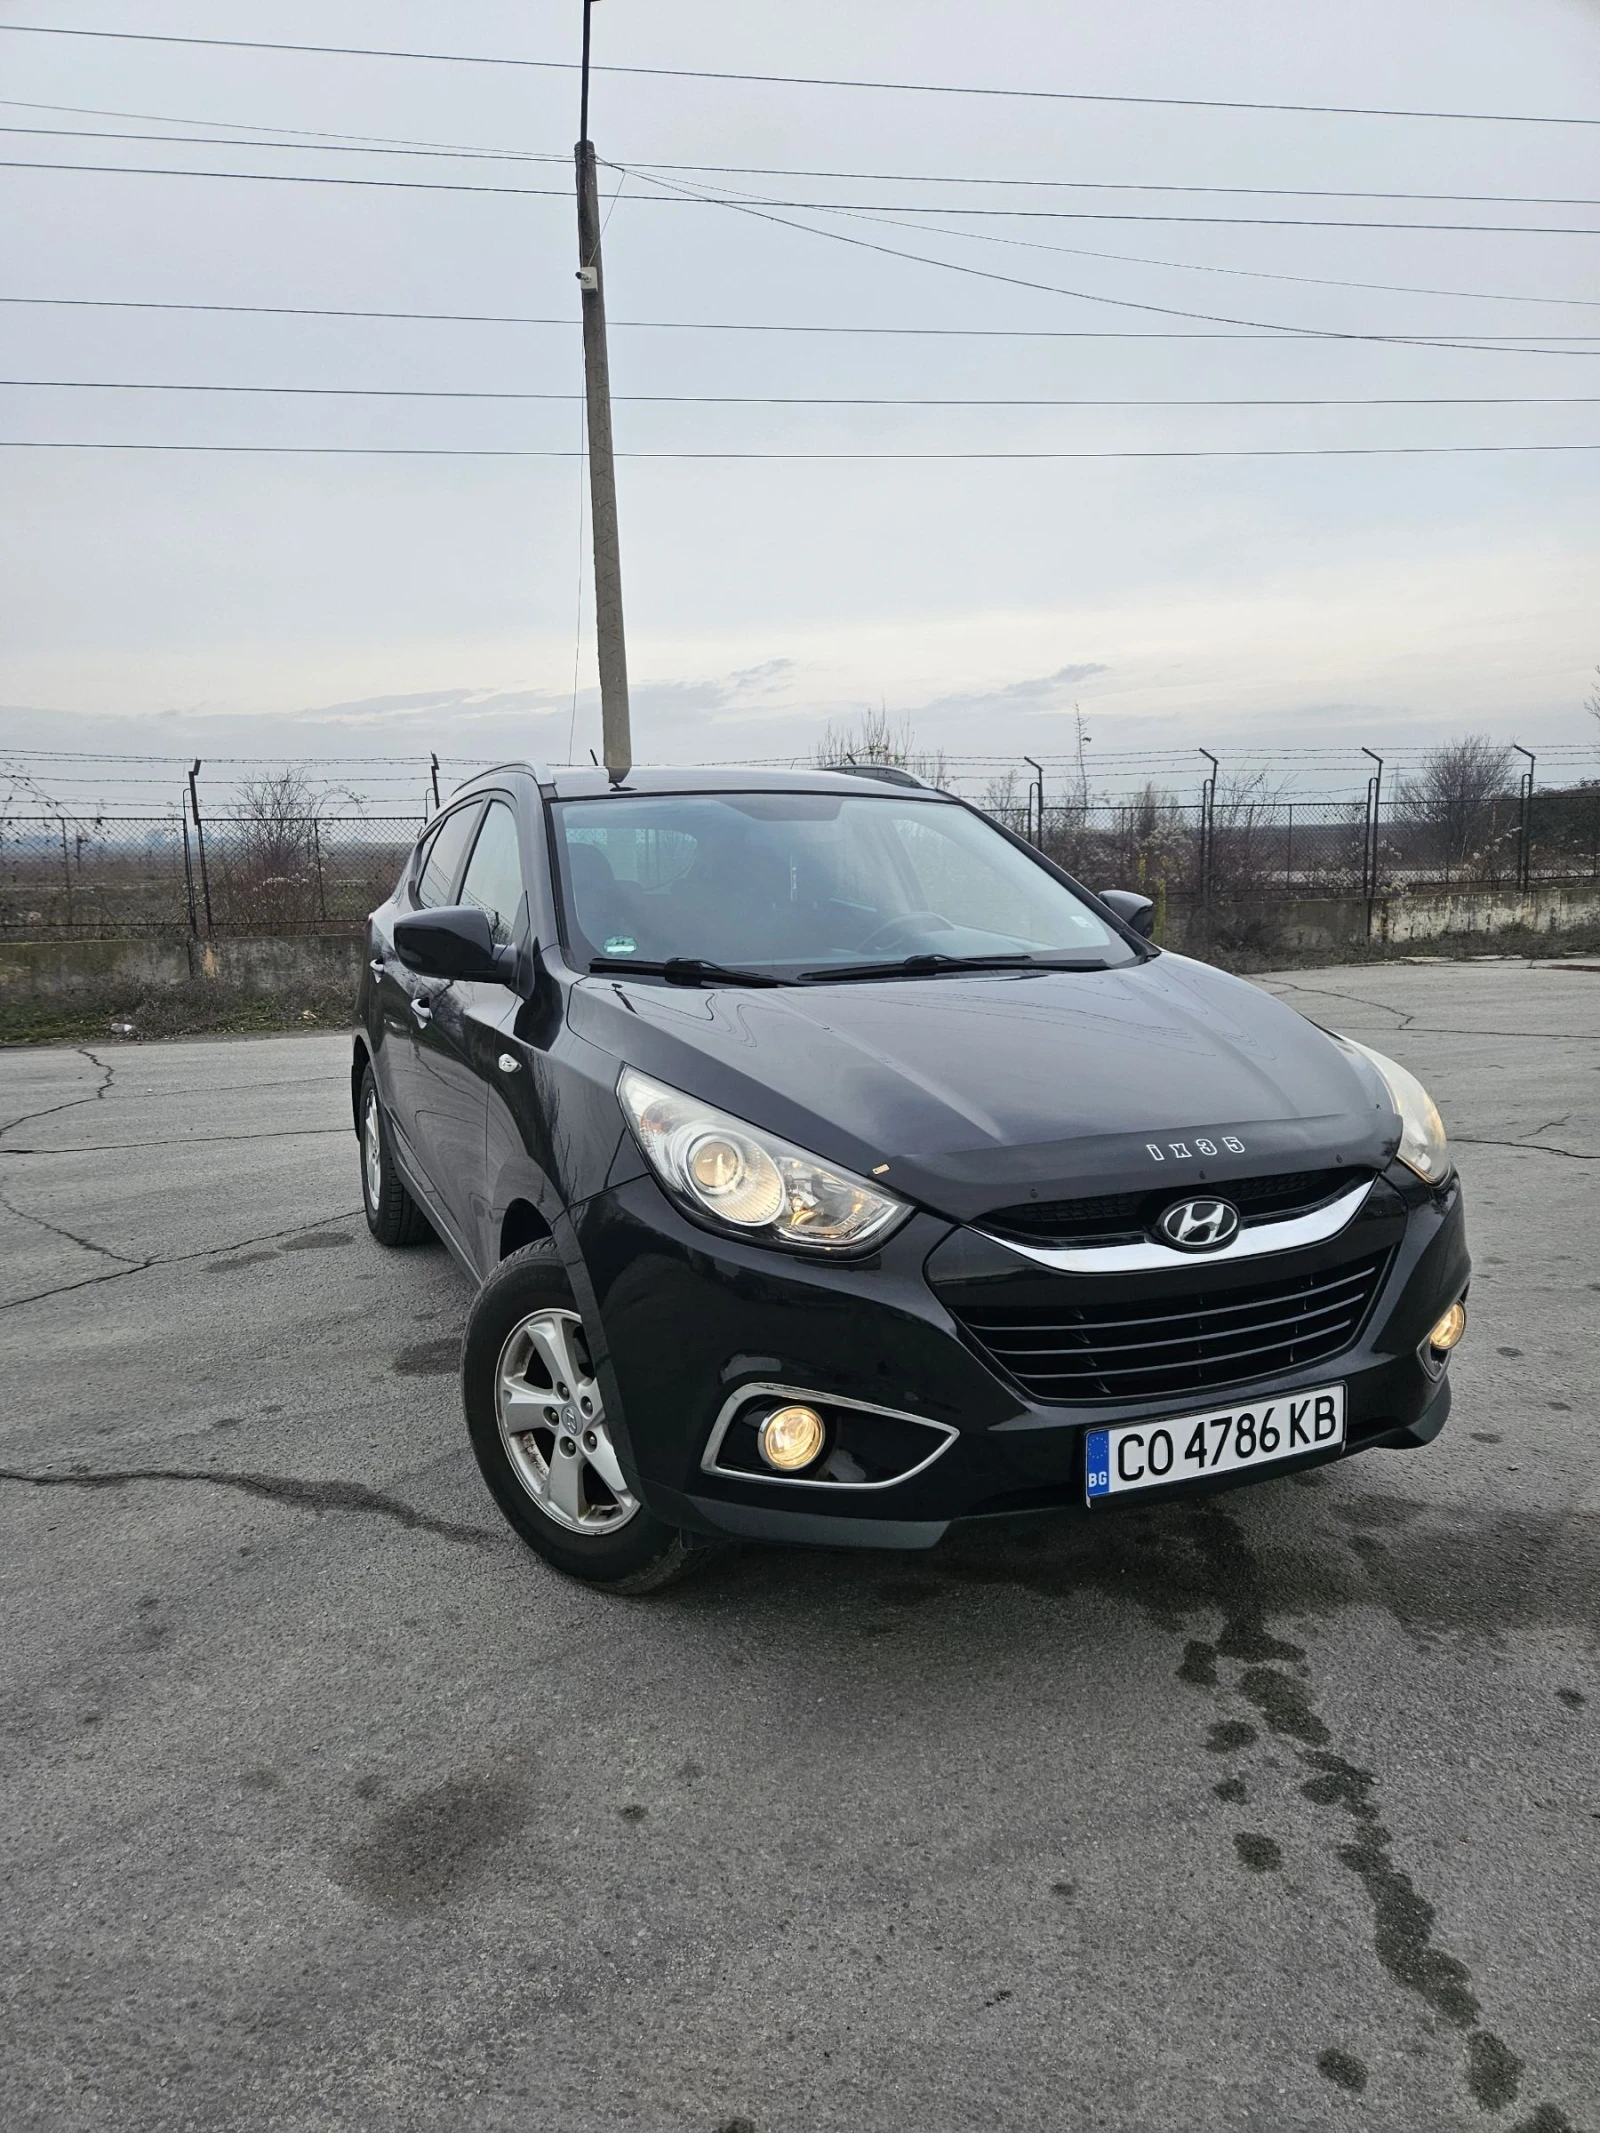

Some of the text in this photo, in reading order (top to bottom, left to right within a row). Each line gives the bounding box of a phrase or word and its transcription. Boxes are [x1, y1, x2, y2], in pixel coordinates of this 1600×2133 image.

[1117, 1395, 1337, 1482] CO 4786 KB
[1088, 1471, 1108, 1488] BG
